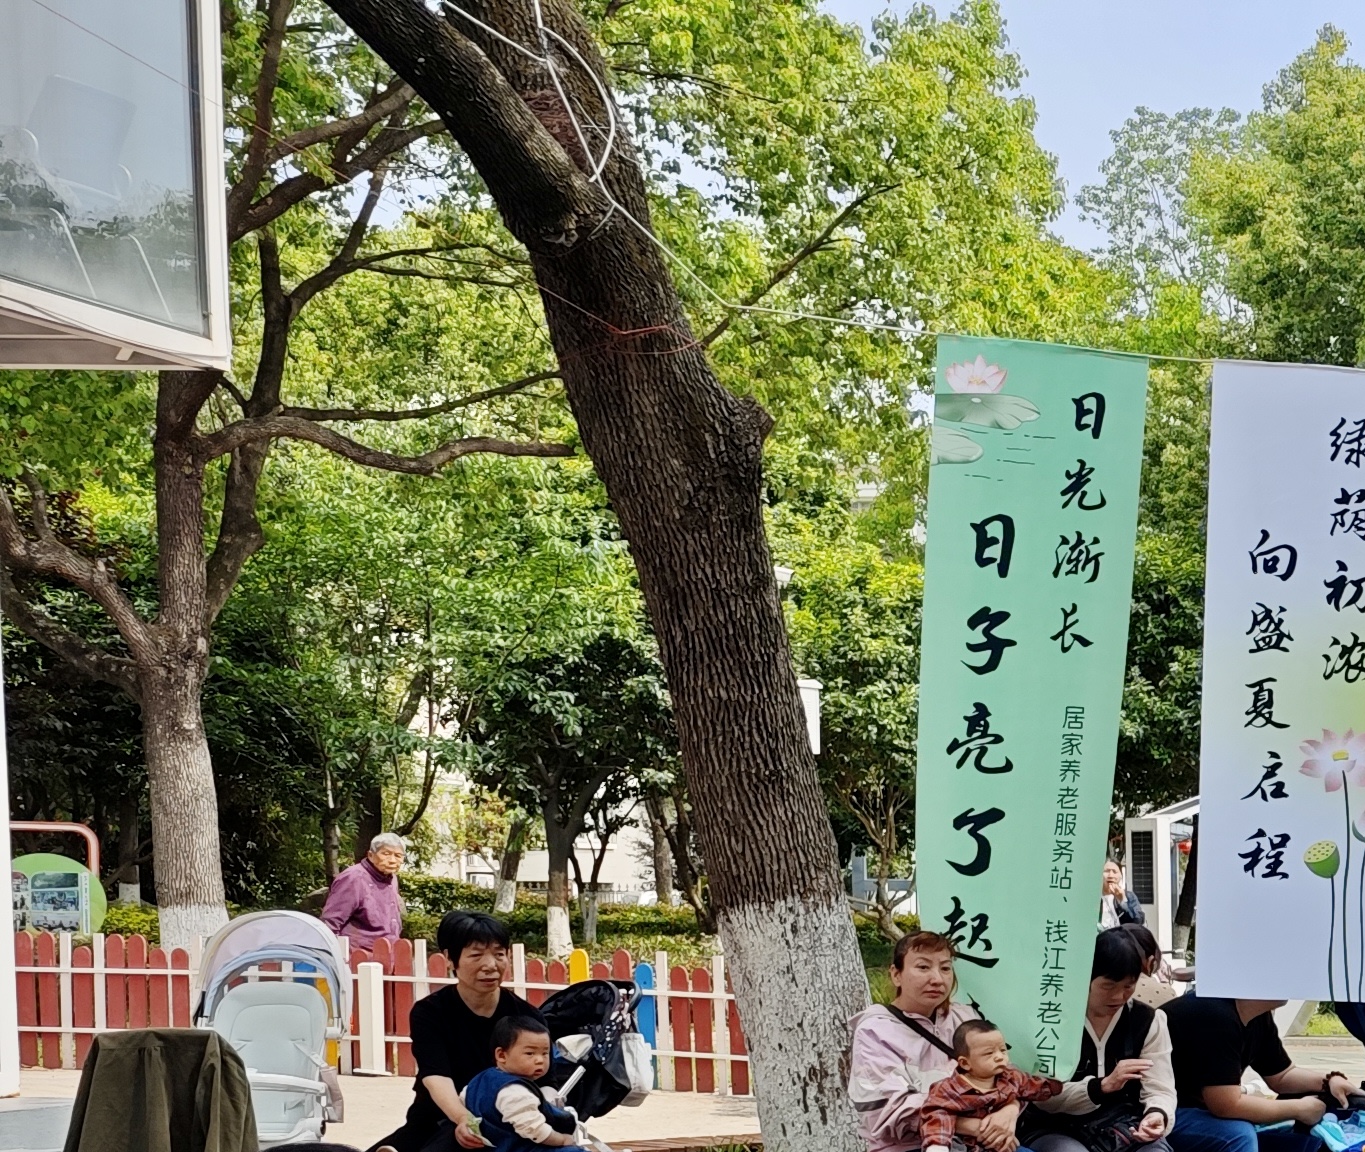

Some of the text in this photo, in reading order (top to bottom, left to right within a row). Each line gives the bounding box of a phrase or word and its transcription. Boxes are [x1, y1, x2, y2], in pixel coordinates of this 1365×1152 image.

[1050, 391, 1107, 654] 日光渐长
[944, 513, 1018, 1050] 日子亮了起
[1237, 529, 1298, 881] 向盛夏启程
